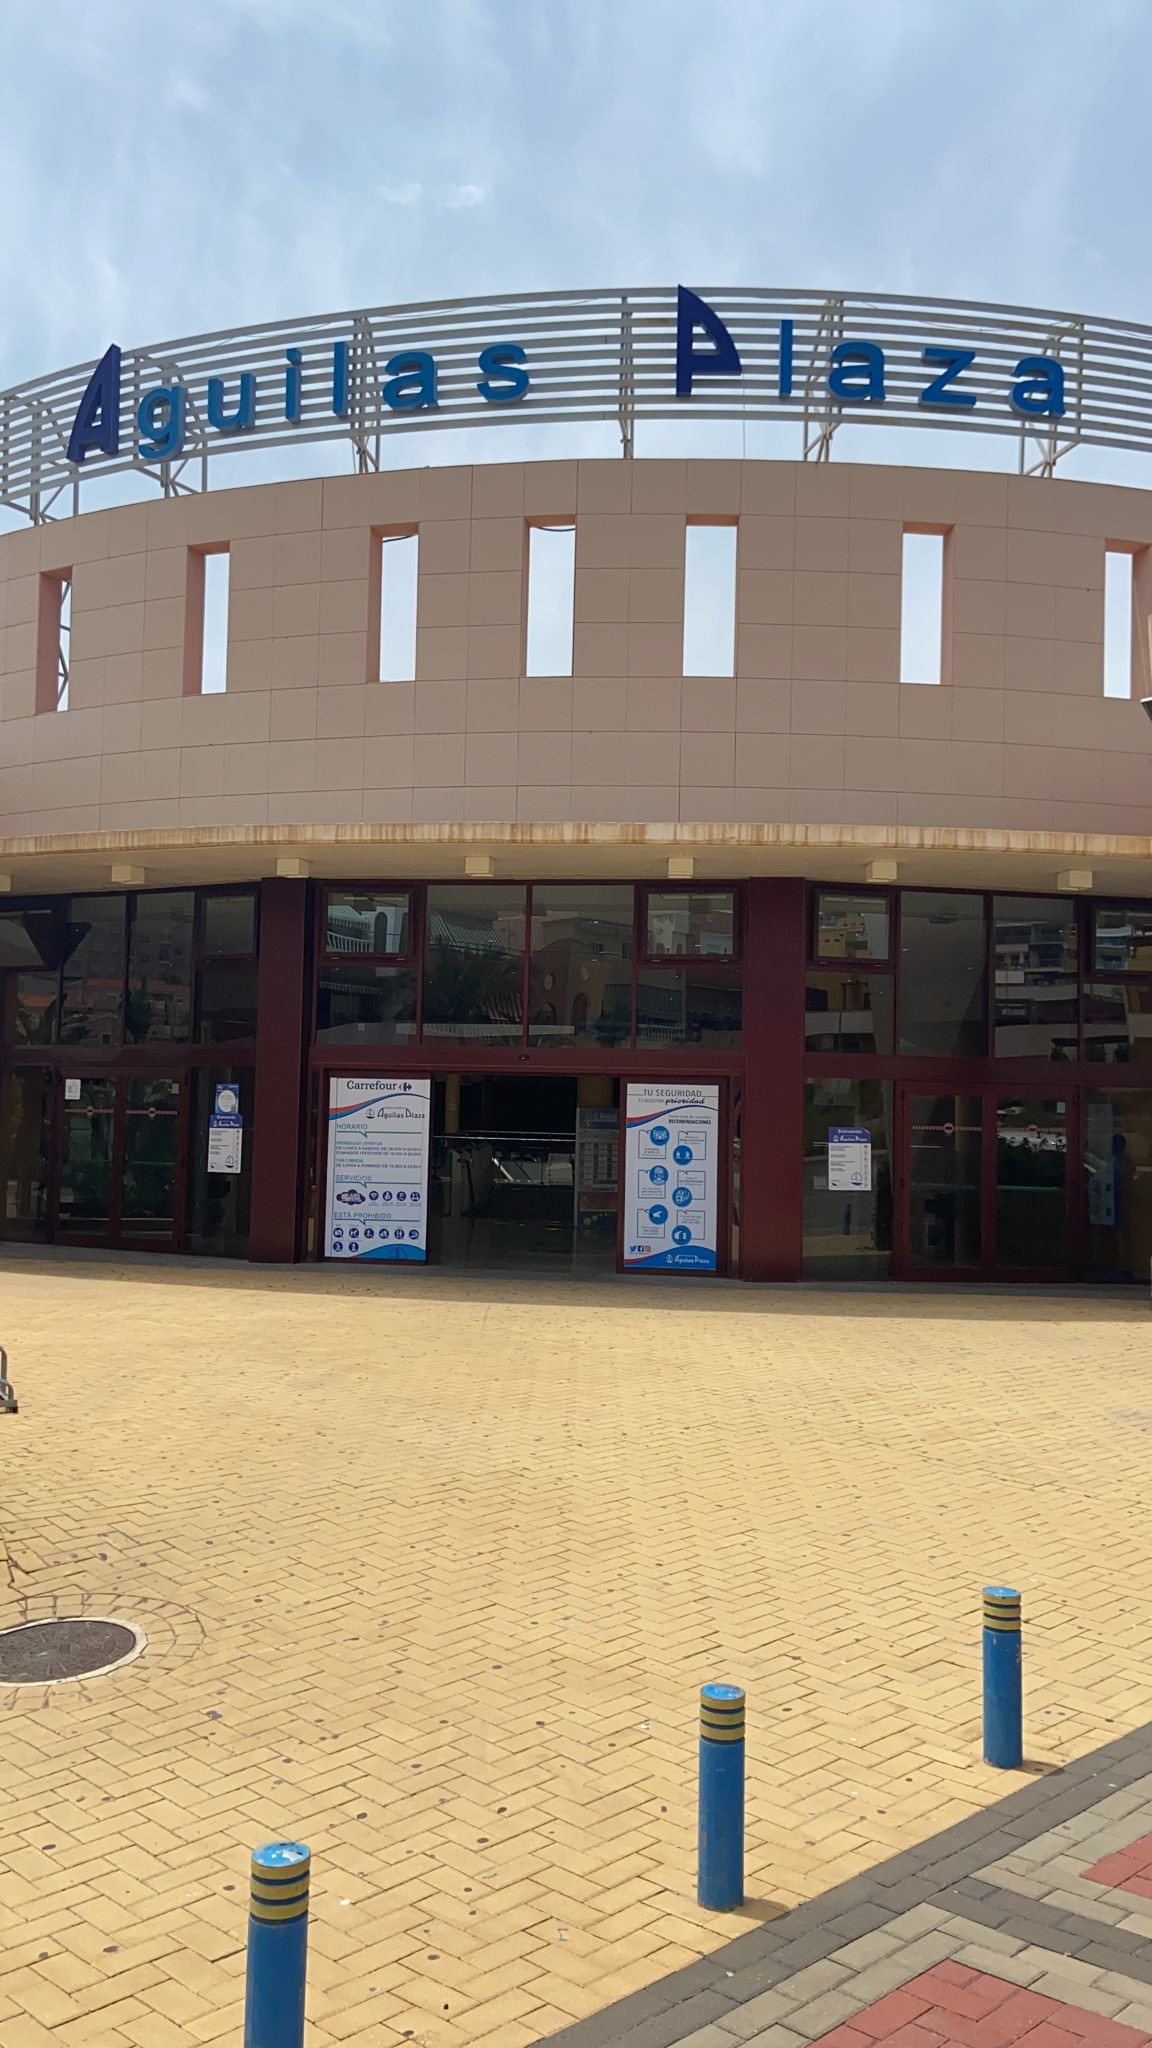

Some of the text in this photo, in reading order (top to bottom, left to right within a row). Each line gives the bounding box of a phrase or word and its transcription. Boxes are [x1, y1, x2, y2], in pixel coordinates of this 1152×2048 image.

[66, 284, 1067, 463] Aguilas Plaza
[346, 1080, 397, 1090] Carrefour
[655, 1089, 703, 1098] SEGURIDAD
[665, 1097, 706, 1106] prioridad
[377, 1107, 425, 1119] Aguilas Plaza
